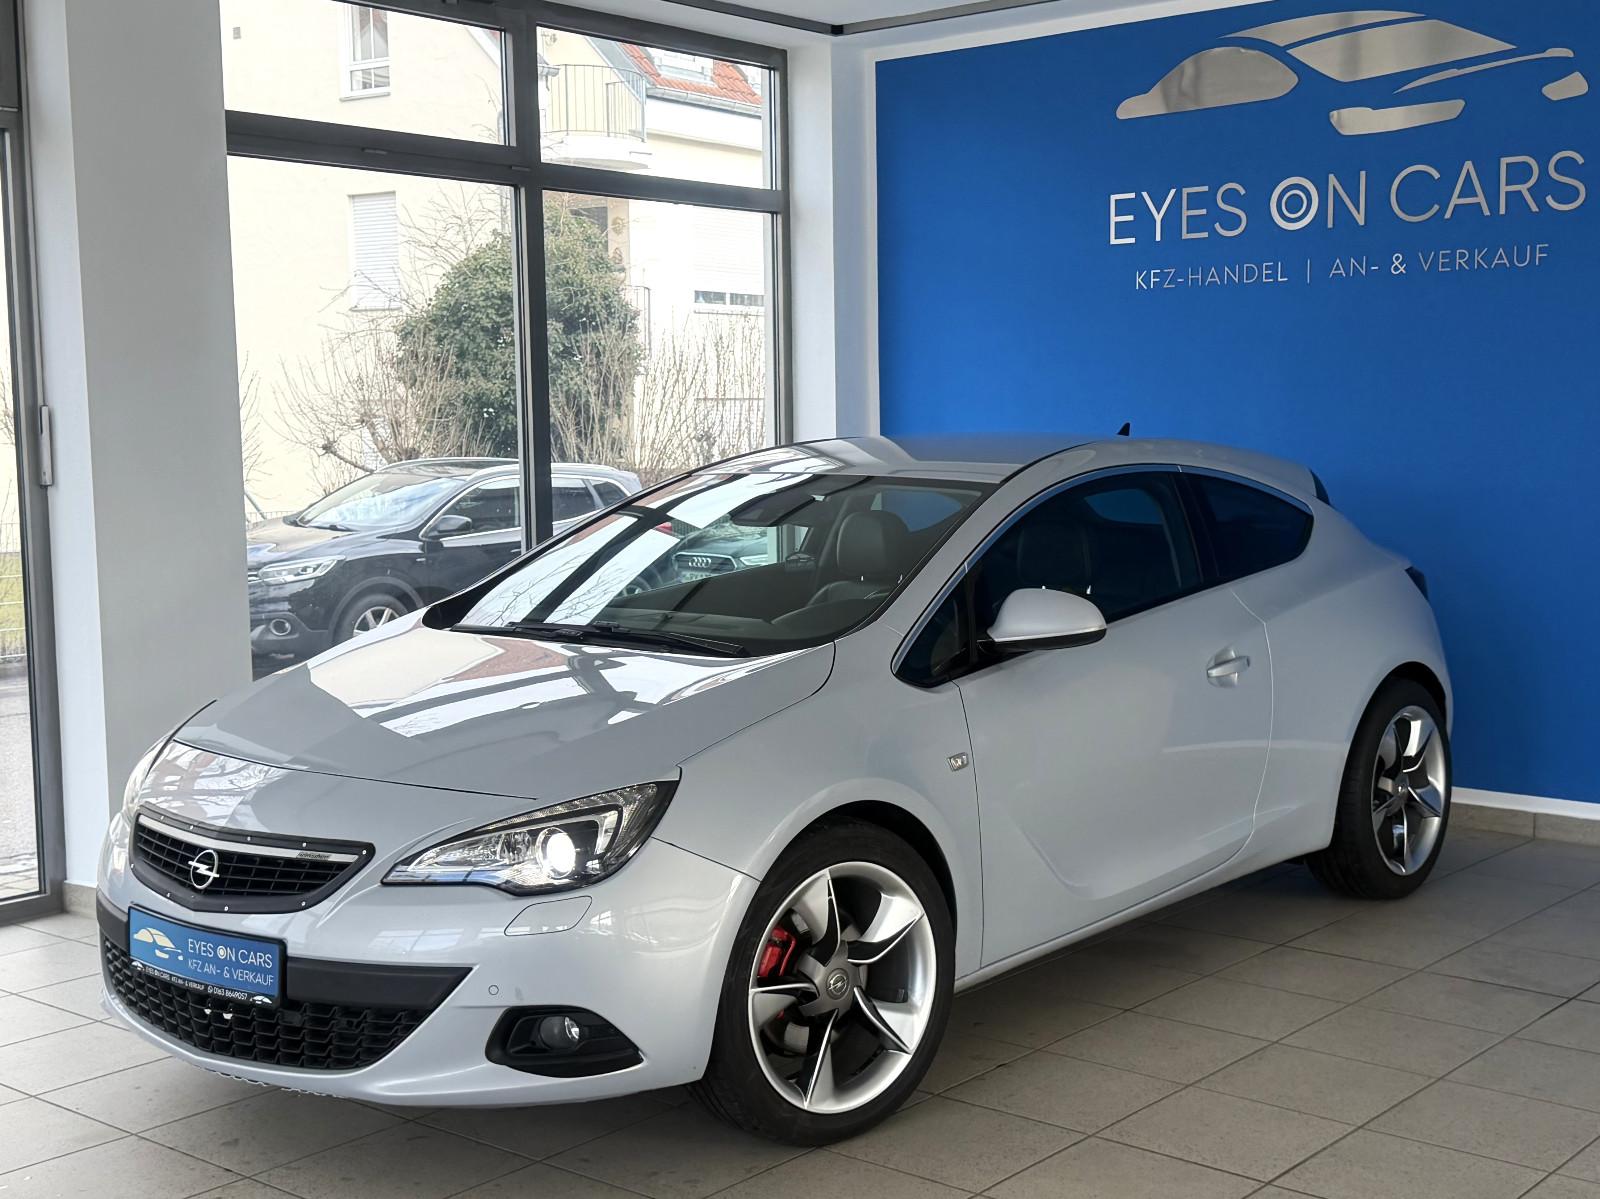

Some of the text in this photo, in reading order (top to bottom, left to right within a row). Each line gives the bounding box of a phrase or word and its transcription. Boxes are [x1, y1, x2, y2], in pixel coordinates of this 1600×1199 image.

[1110, 150, 1586, 245] EYES ON CARS
[1135, 261, 1288, 290] KFZ-HANDEL
[1329, 256, 1379, 278] AN-
[1390, 253, 1407, 275] &
[1418, 244, 1549, 273] VERKAUF
[188, 938, 273, 969] EYES ON CARS
[188, 959, 274, 986] KFZ AN- & VERKAUF
